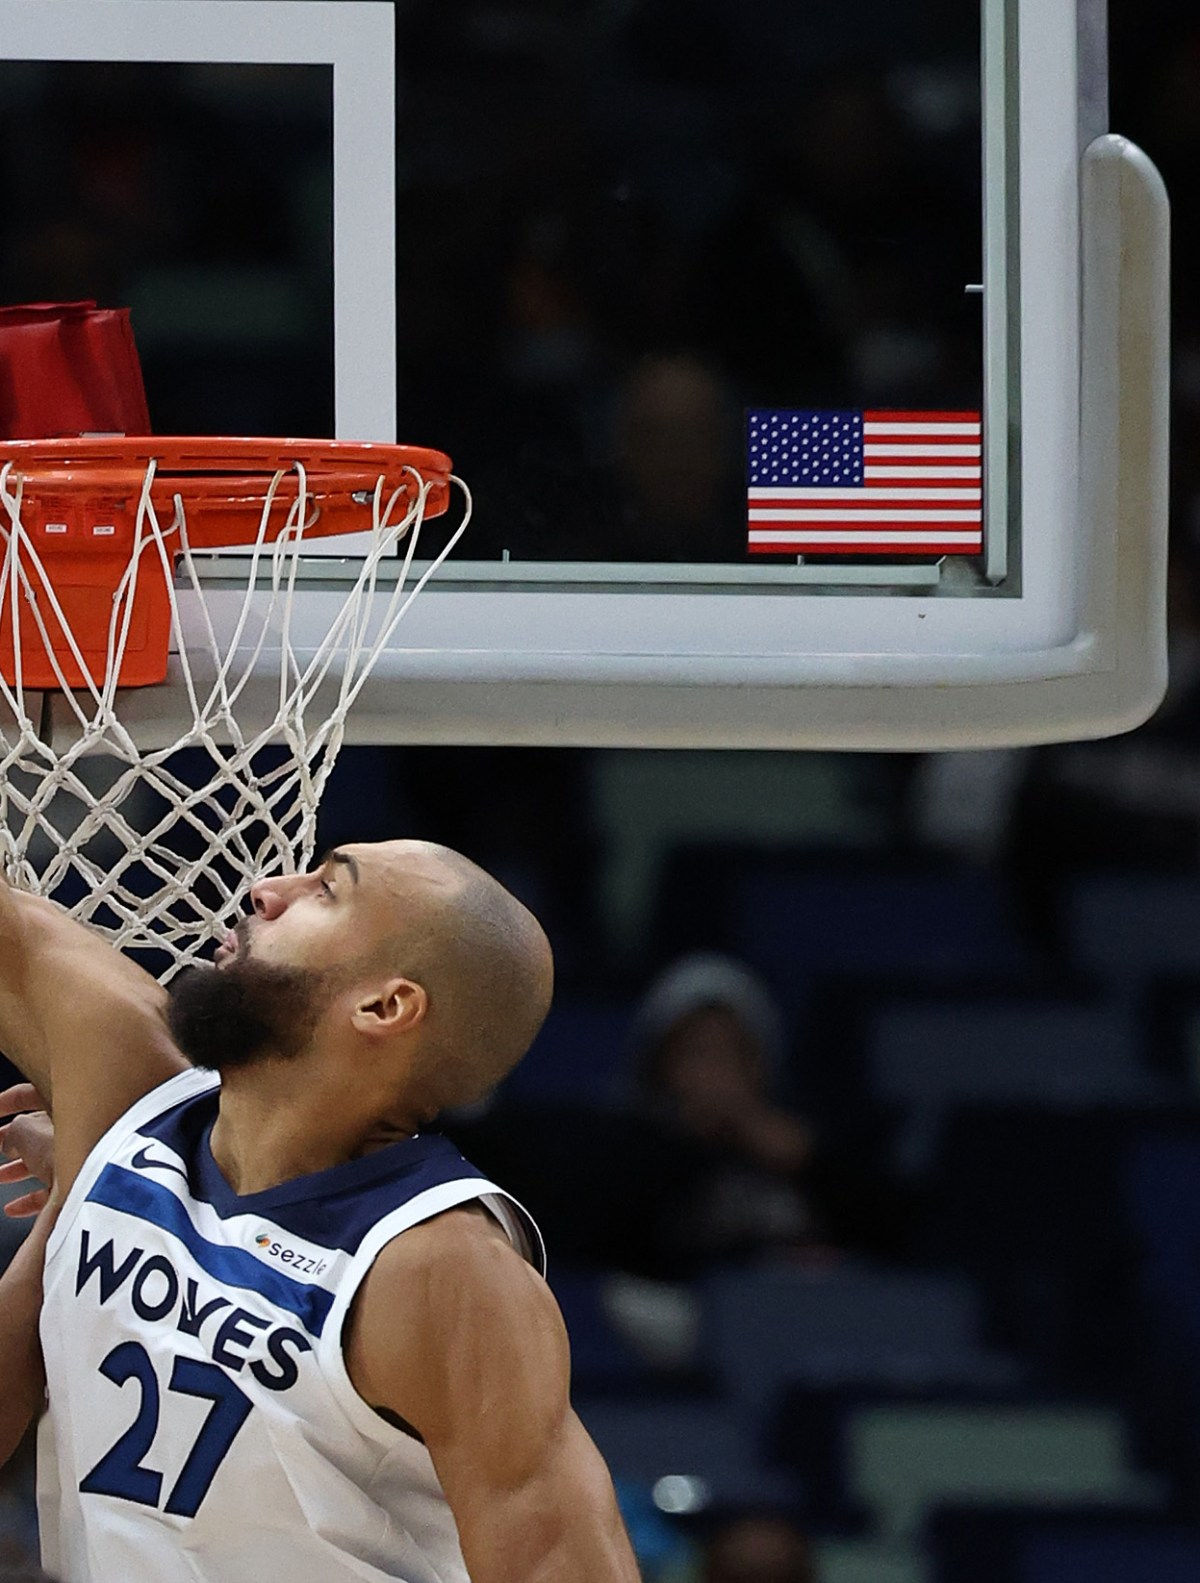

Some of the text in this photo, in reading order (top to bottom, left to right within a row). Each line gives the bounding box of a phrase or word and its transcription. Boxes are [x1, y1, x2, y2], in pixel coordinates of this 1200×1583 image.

[76, 1229, 312, 1391] WOLVES
[268, 1242, 327, 1276] sezzle
[78, 1340, 255, 1518] 27
